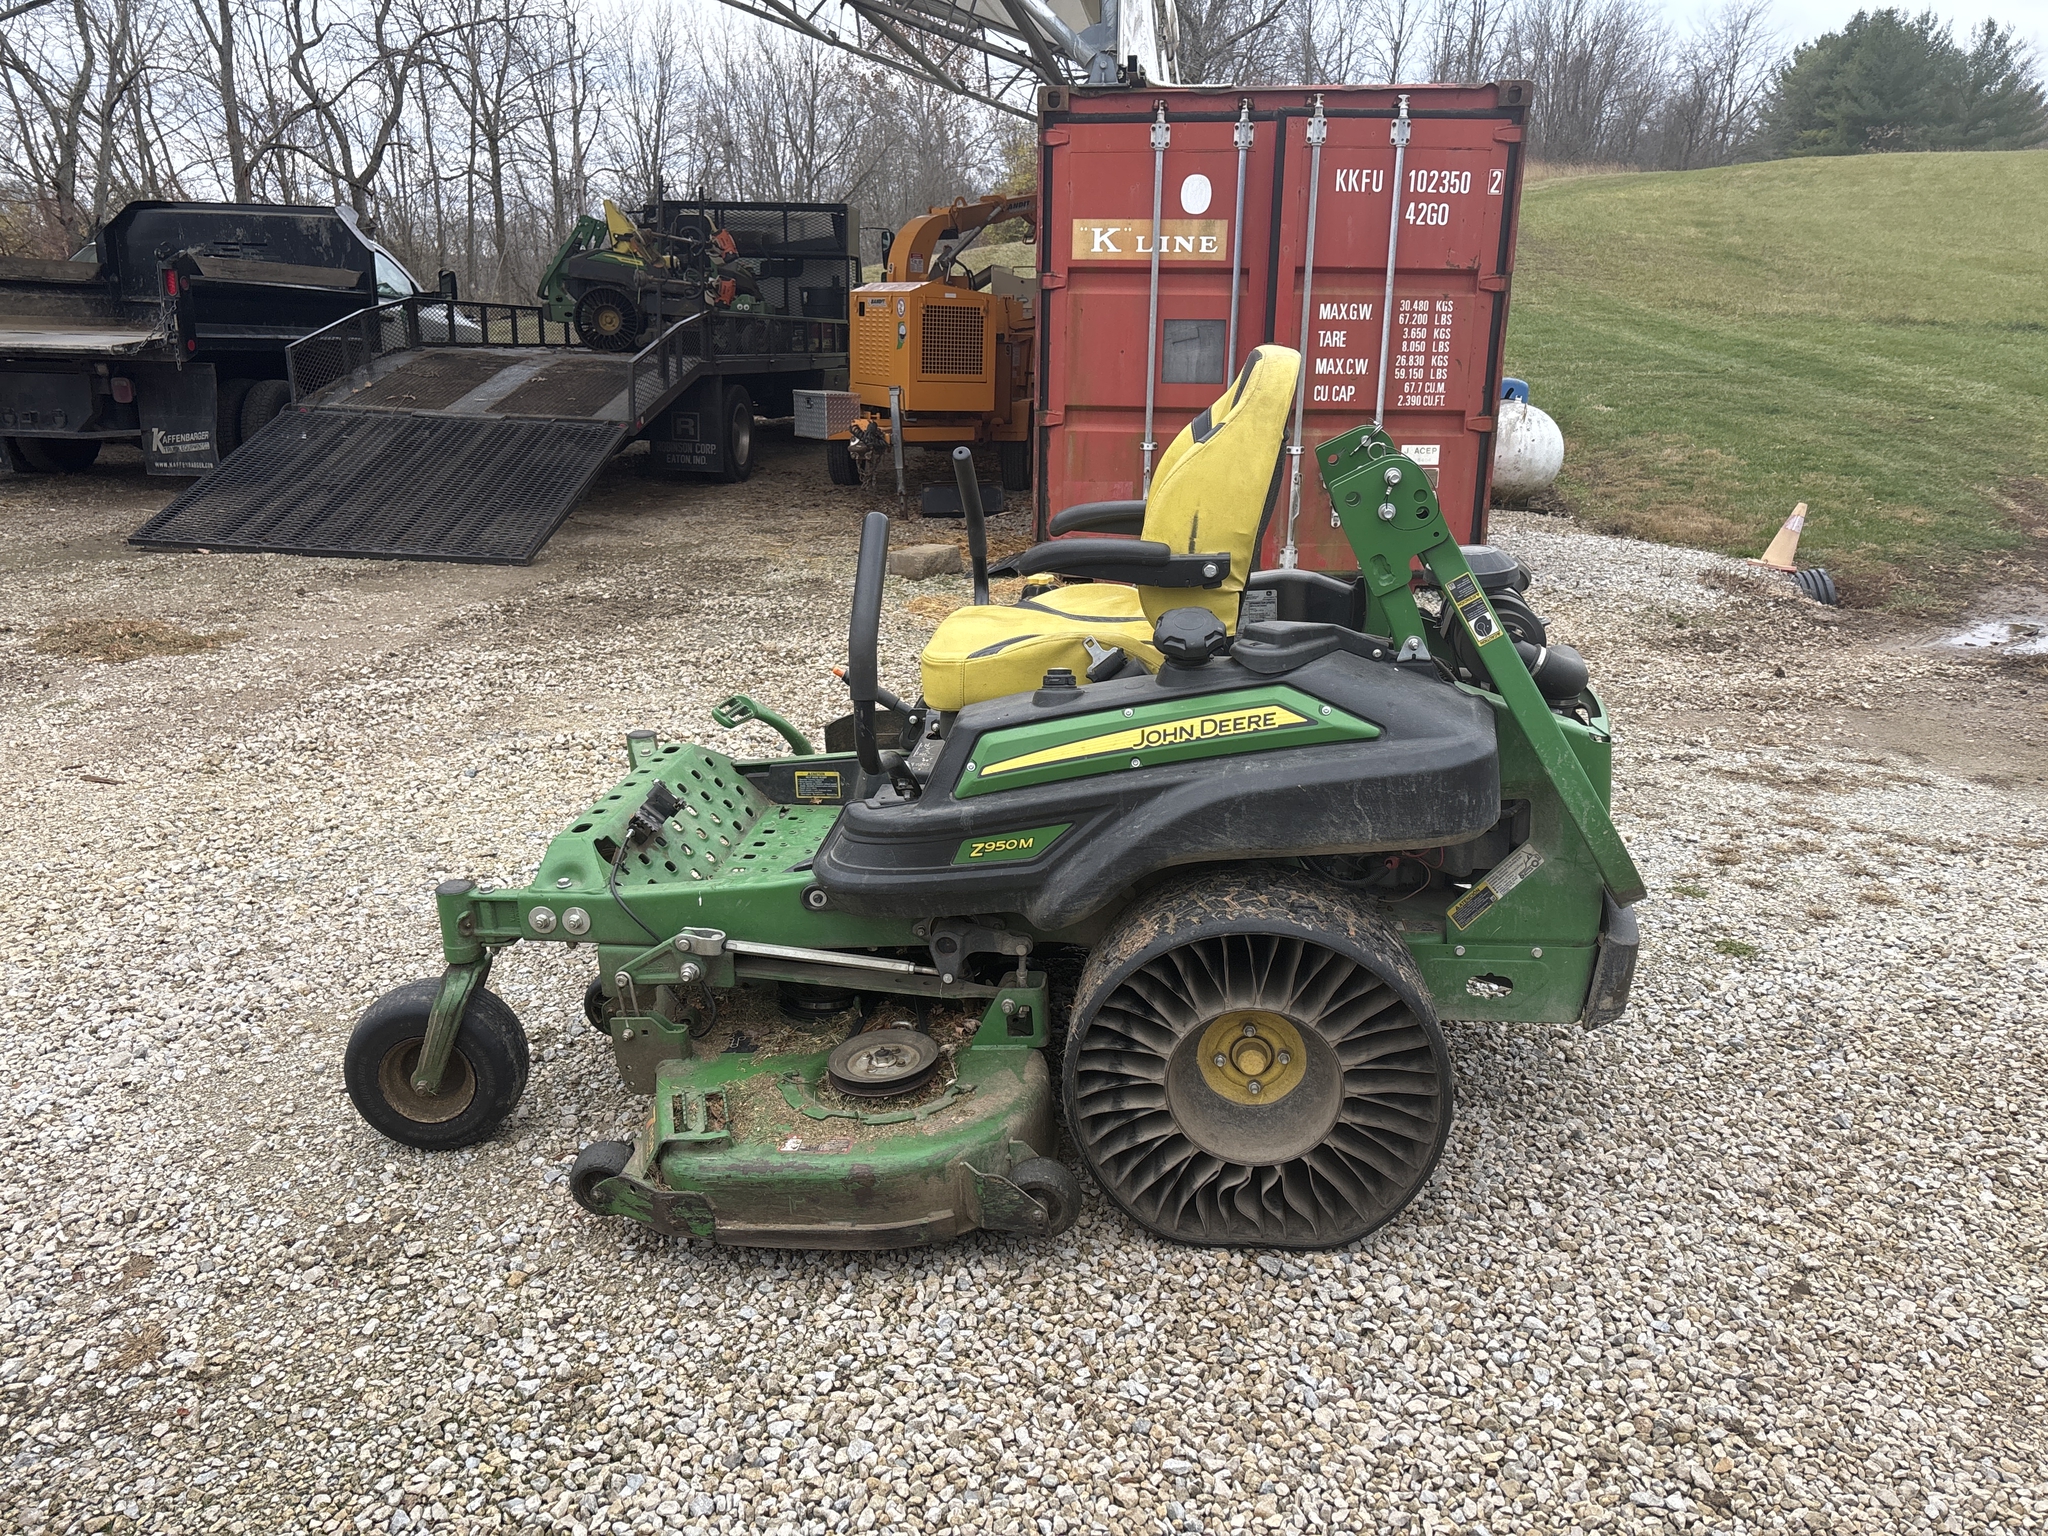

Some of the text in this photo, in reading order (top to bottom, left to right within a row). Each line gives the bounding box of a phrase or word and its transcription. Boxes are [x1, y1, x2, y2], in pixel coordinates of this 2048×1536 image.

[1335, 169, 1502, 194] KKFU 102350 2
[1136, 235, 1218, 253] LINE
[1319, 303, 1373, 320] MAX.G.W.
[1399, 300, 1454, 312] 30.480 KGS
[1398, 313, 1453, 325] 67.200 LBS
[1318, 331, 1347, 347] TARE
[1402, 327, 1451, 340] 3.650 KGS
[1401, 340, 1450, 353] 8.050 LBS
[1315, 358, 1369, 375] MAX.C.W.
[1395, 355, 1449, 367] 26.830 KGS
[1394, 368, 1447, 380] 59.150 LBS
[1403, 382, 1422, 393] 67.7
[1397, 395, 1422, 407] 2.390
[676, 417, 695, 436] R
[152, 428, 209, 454] KAFFENBARGER
[656, 441, 717, 455] ROBINSON CORP.
[1414, 447, 1438, 455] ACEP
[1132, 712, 1277, 748] JOHN DEERE
[969, 838, 1034, 858] Z950M
